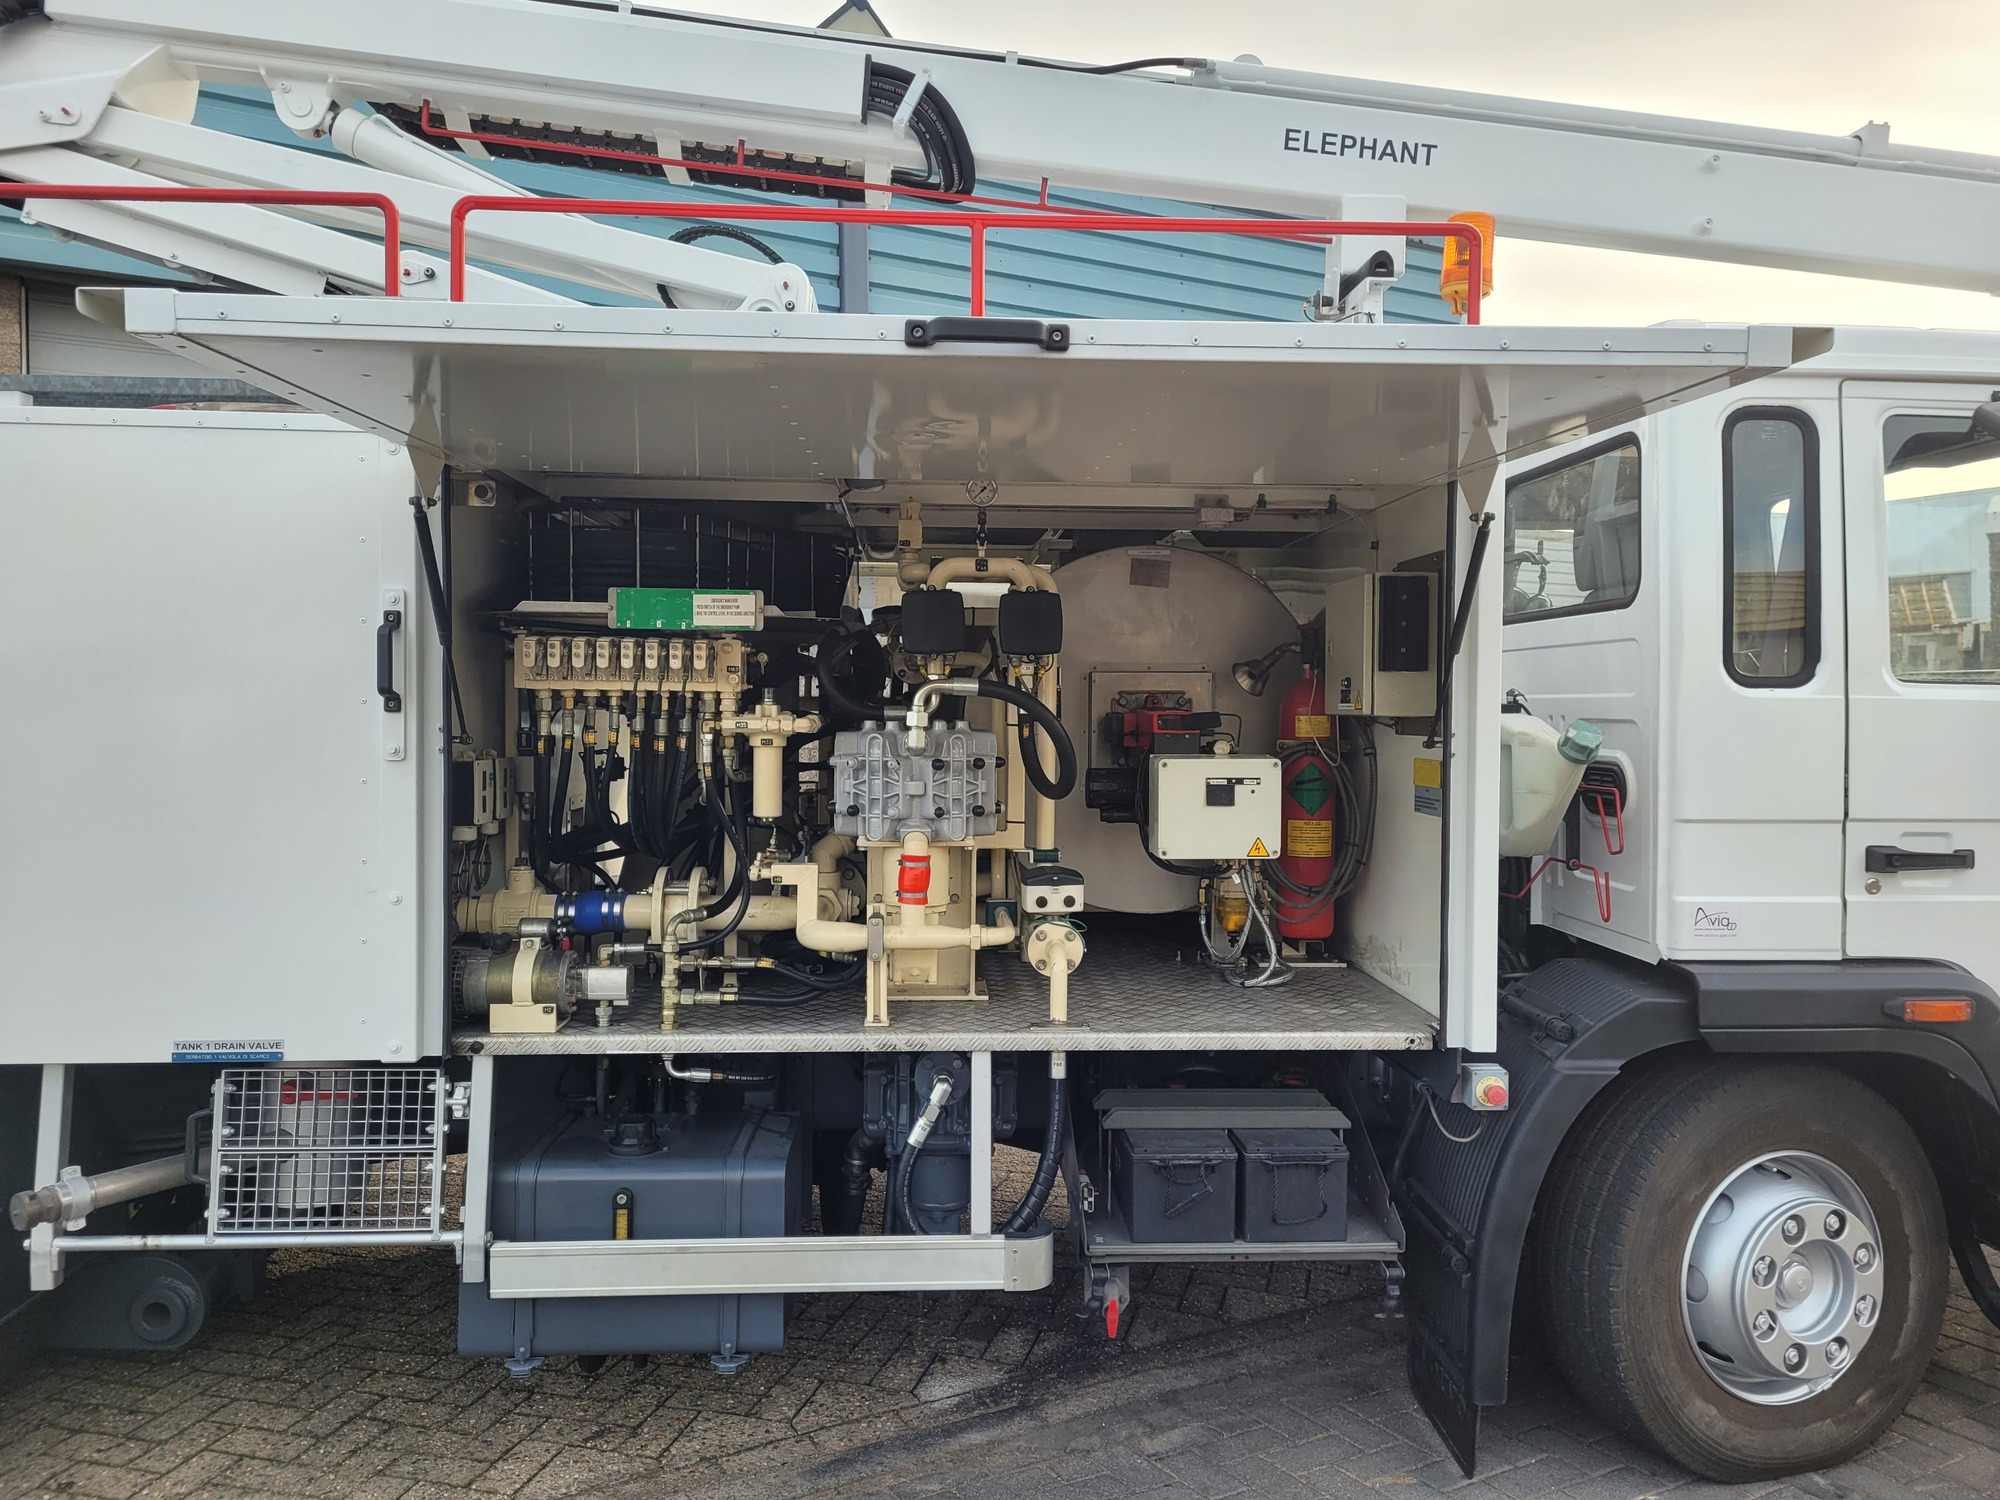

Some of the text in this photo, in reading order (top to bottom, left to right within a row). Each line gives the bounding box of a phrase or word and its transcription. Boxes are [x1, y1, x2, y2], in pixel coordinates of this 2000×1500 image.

[1283, 128, 1438, 166] ELEPHANT
[214, 1042, 246, 1050] DRAIN
[248, 1041, 282, 1049] VALVE
